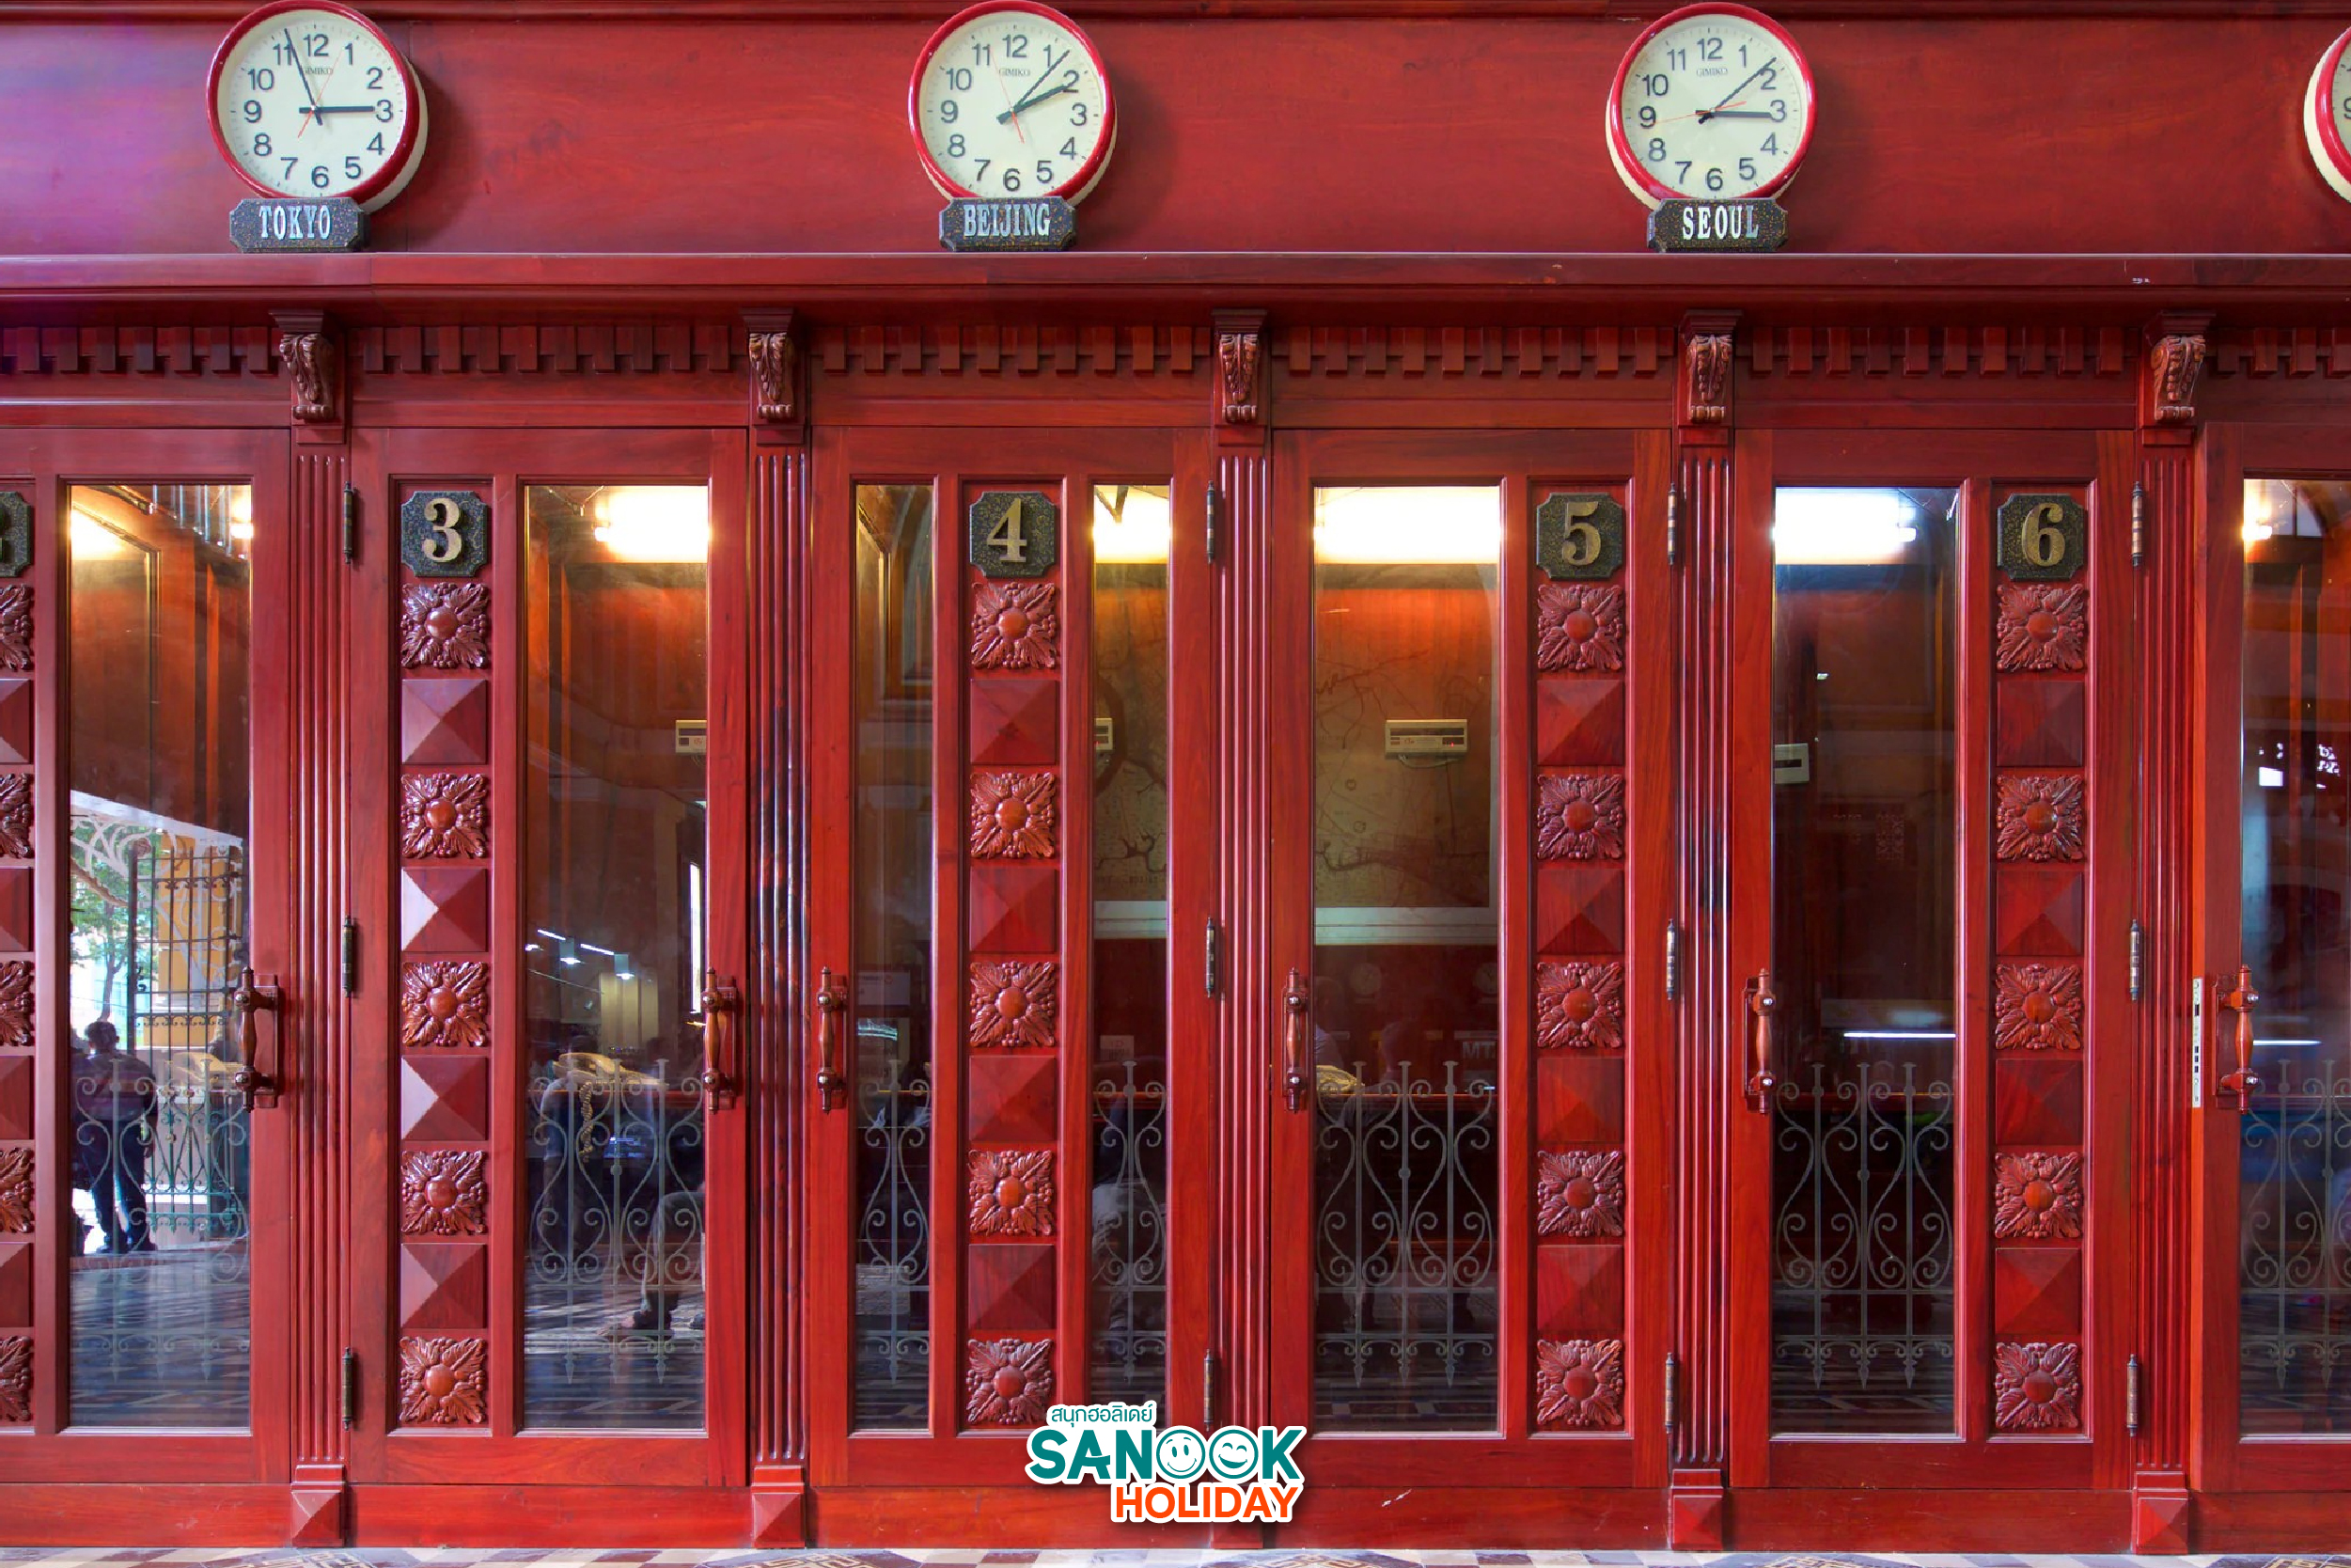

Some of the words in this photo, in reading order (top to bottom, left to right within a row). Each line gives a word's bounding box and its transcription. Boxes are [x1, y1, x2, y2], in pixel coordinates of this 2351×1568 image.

[273, 44, 293, 65] 11
[304, 34, 329, 56] 12
[345, 43, 353, 65] 1
[972, 44, 990, 66] 11
[1003, 35, 1027, 57] 12
[1043, 45, 1051, 66] 1
[1697, 38, 1722, 60] 12
[1739, 45, 1747, 67] 1
[1668, 50, 1685, 71] 11
[248, 69, 274, 90] 10
[367, 68, 383, 89] 2
[947, 69, 971, 90] 10
[1063, 70, 1078, 92] 2
[1642, 74, 1668, 96] 10
[1761, 68, 1777, 90] 2
[244, 101, 261, 122] 9
[376, 100, 393, 122] 3
[941, 101, 958, 123] 9
[1070, 103, 1087, 126] 3
[1639, 106, 1655, 129] 9
[1770, 101, 1785, 122] 3
[254, 133, 272, 156] 8
[367, 133, 384, 155] 4
[948, 134, 964, 157] 8
[1060, 137, 1076, 160] 4
[1649, 138, 1666, 161] 8
[1761, 133, 1778, 155] 4
[281, 157, 298, 180] 7
[312, 166, 328, 188] 6
[345, 157, 361, 179] 5
[975, 160, 991, 181] 7
[1037, 161, 1052, 183] 5
[1675, 162, 1692, 183] 7
[1740, 158, 1756, 180] 5
[1004, 168, 1020, 191] 6
[1706, 168, 1723, 191] 6
[259, 205, 330, 240] TOKYO
[964, 204, 1050, 237] BEIJING
[1683, 205, 1759, 240] SEOUL
[422, 497, 462, 562] 3
[986, 498, 1027, 562] 4
[1562, 501, 1601, 566] 5
[2022, 502, 2065, 567] 6
